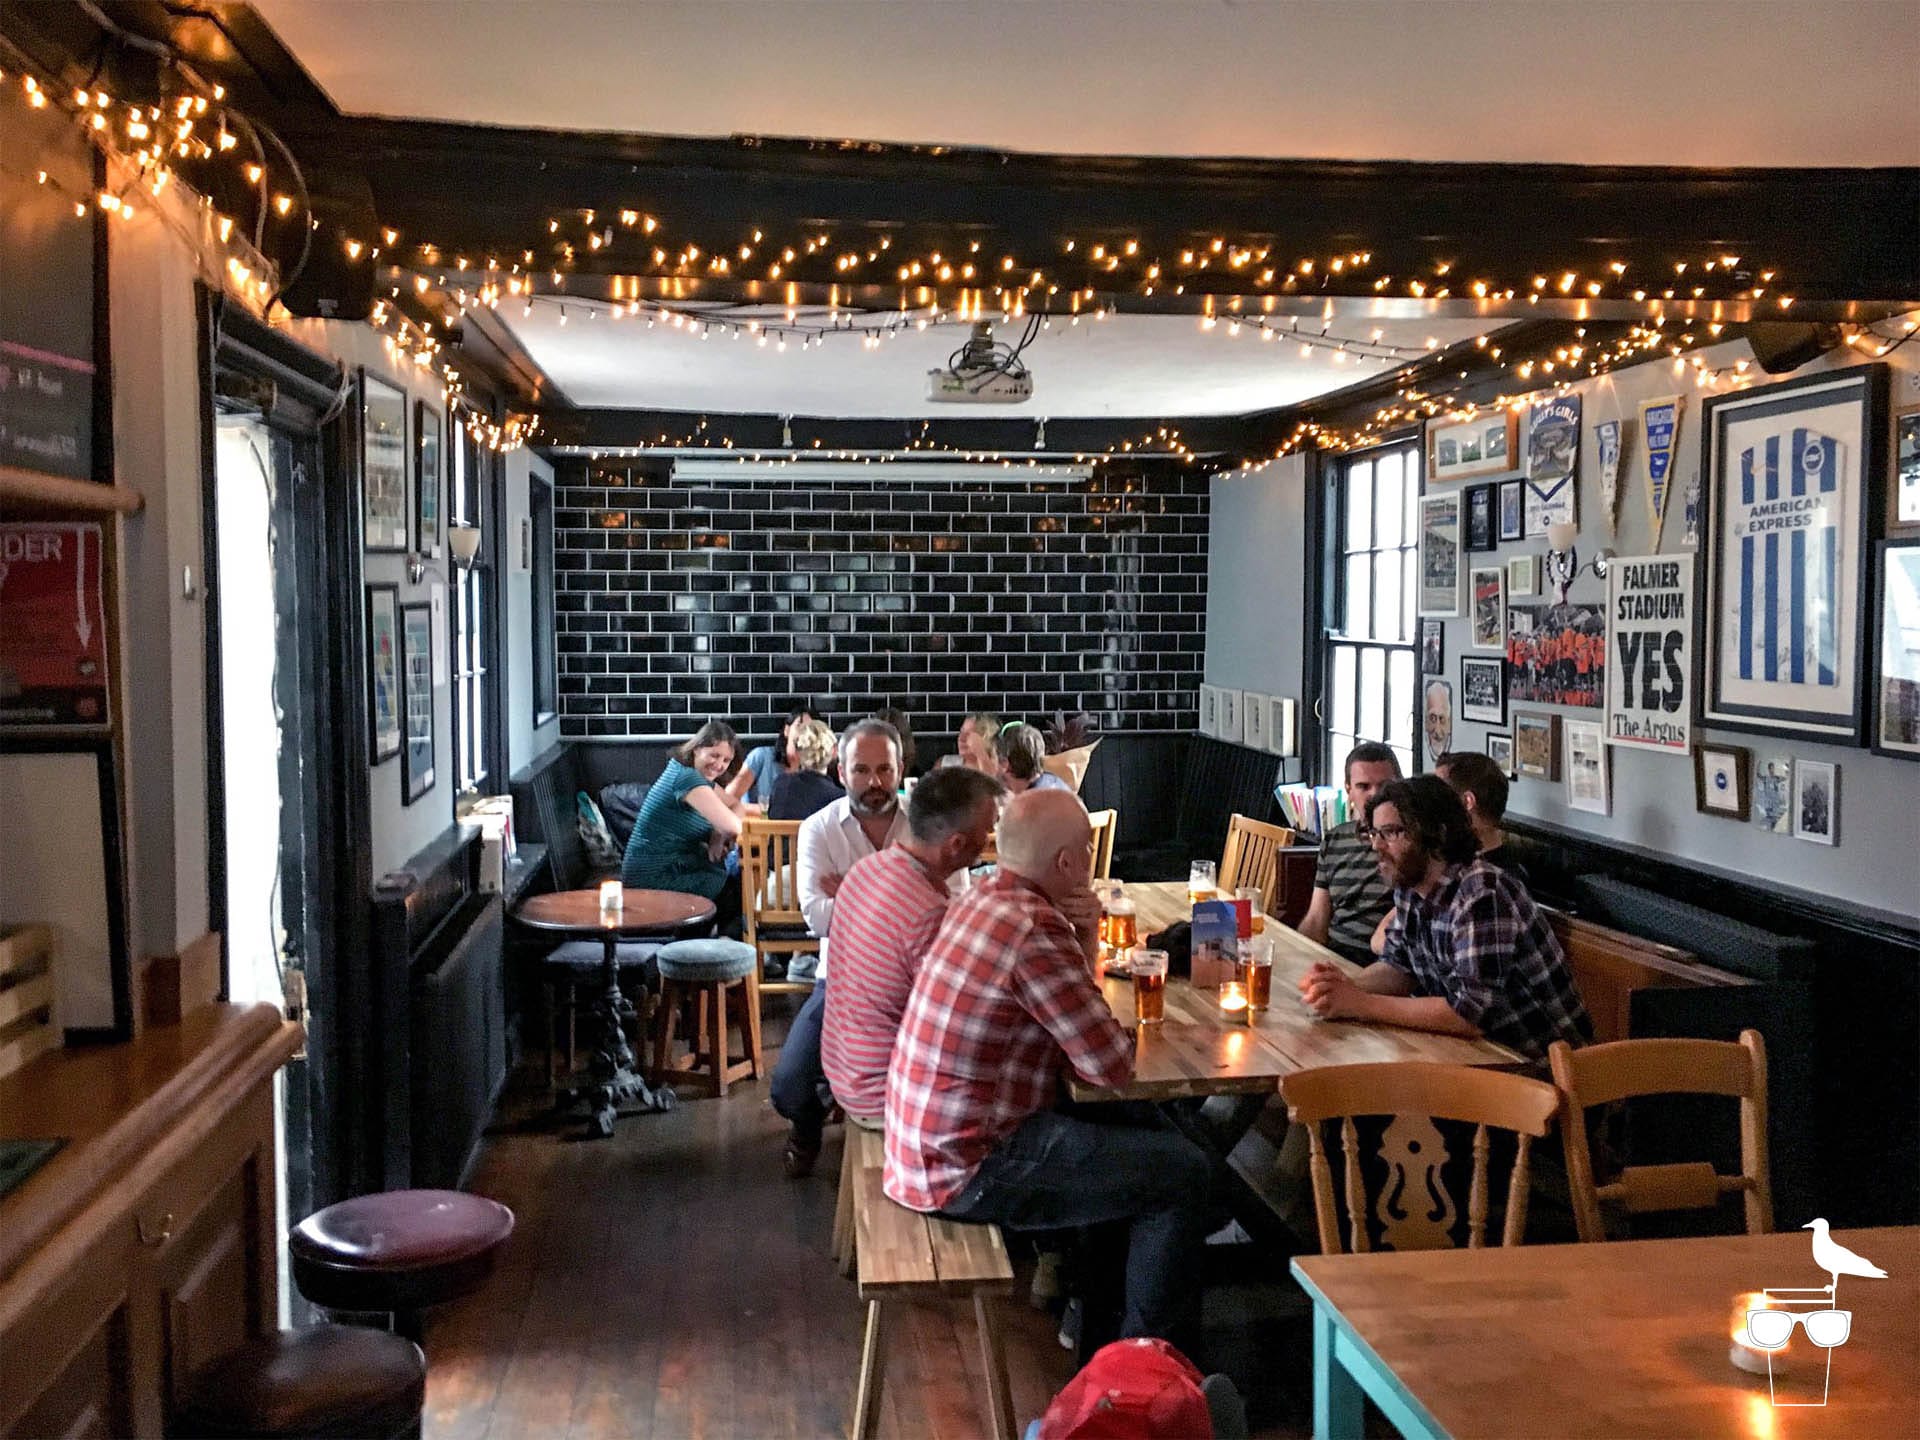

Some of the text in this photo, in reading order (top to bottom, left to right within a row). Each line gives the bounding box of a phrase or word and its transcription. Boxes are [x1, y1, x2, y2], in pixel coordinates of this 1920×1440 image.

[1555, 405, 1578, 426] GIRLS
[1750, 497, 1823, 518] AMERICAN
[1749, 514, 1813, 532] EXPRESS
[0, 533, 62, 562] DER
[1623, 562, 1680, 590] FALMER
[1618, 593, 1684, 620] STADIUM
[1617, 630, 1684, 713] YES
[1613, 713, 1685, 744] The Argus
